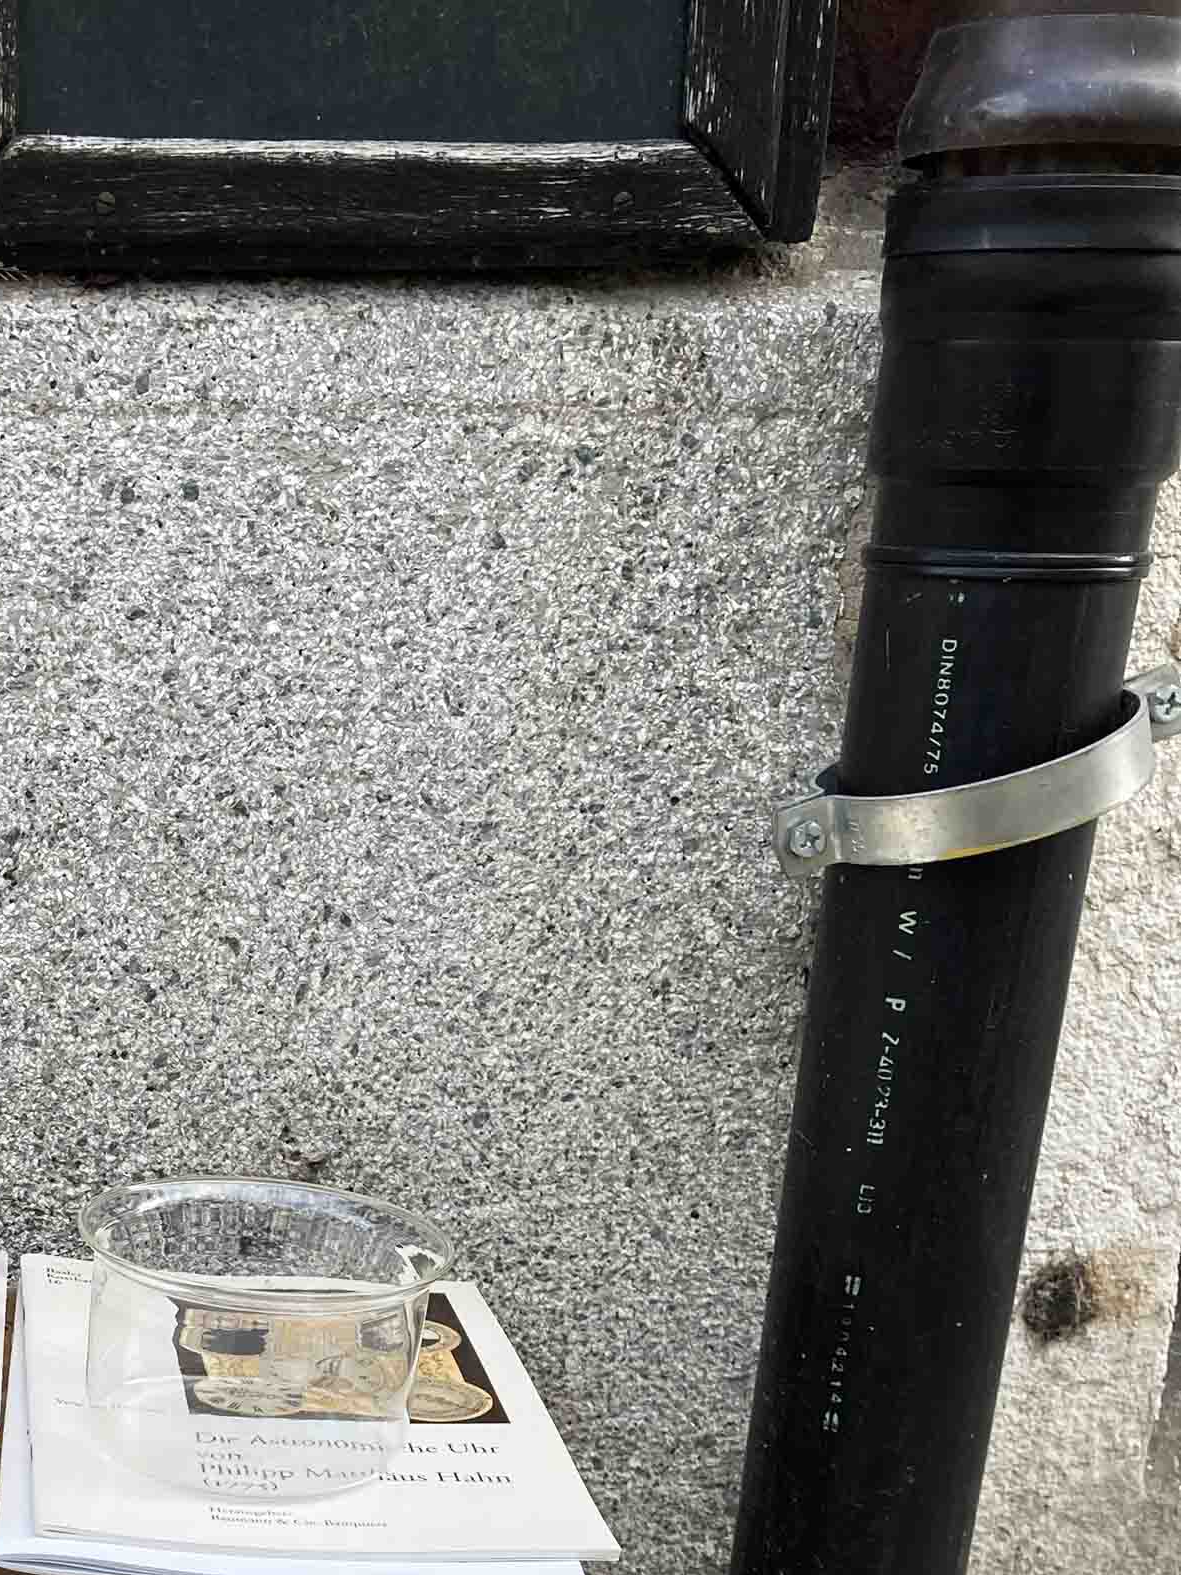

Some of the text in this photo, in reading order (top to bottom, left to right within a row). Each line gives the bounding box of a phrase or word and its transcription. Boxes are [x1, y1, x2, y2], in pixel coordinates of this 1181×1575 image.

[923, 637, 958, 775] DIN8074/75
[899, 910, 918, 938] W
[447, 1442, 500, 1455] Uhr
[199, 1463, 295, 1482] Philipp
[436, 1471, 512, 1485] Hahn
